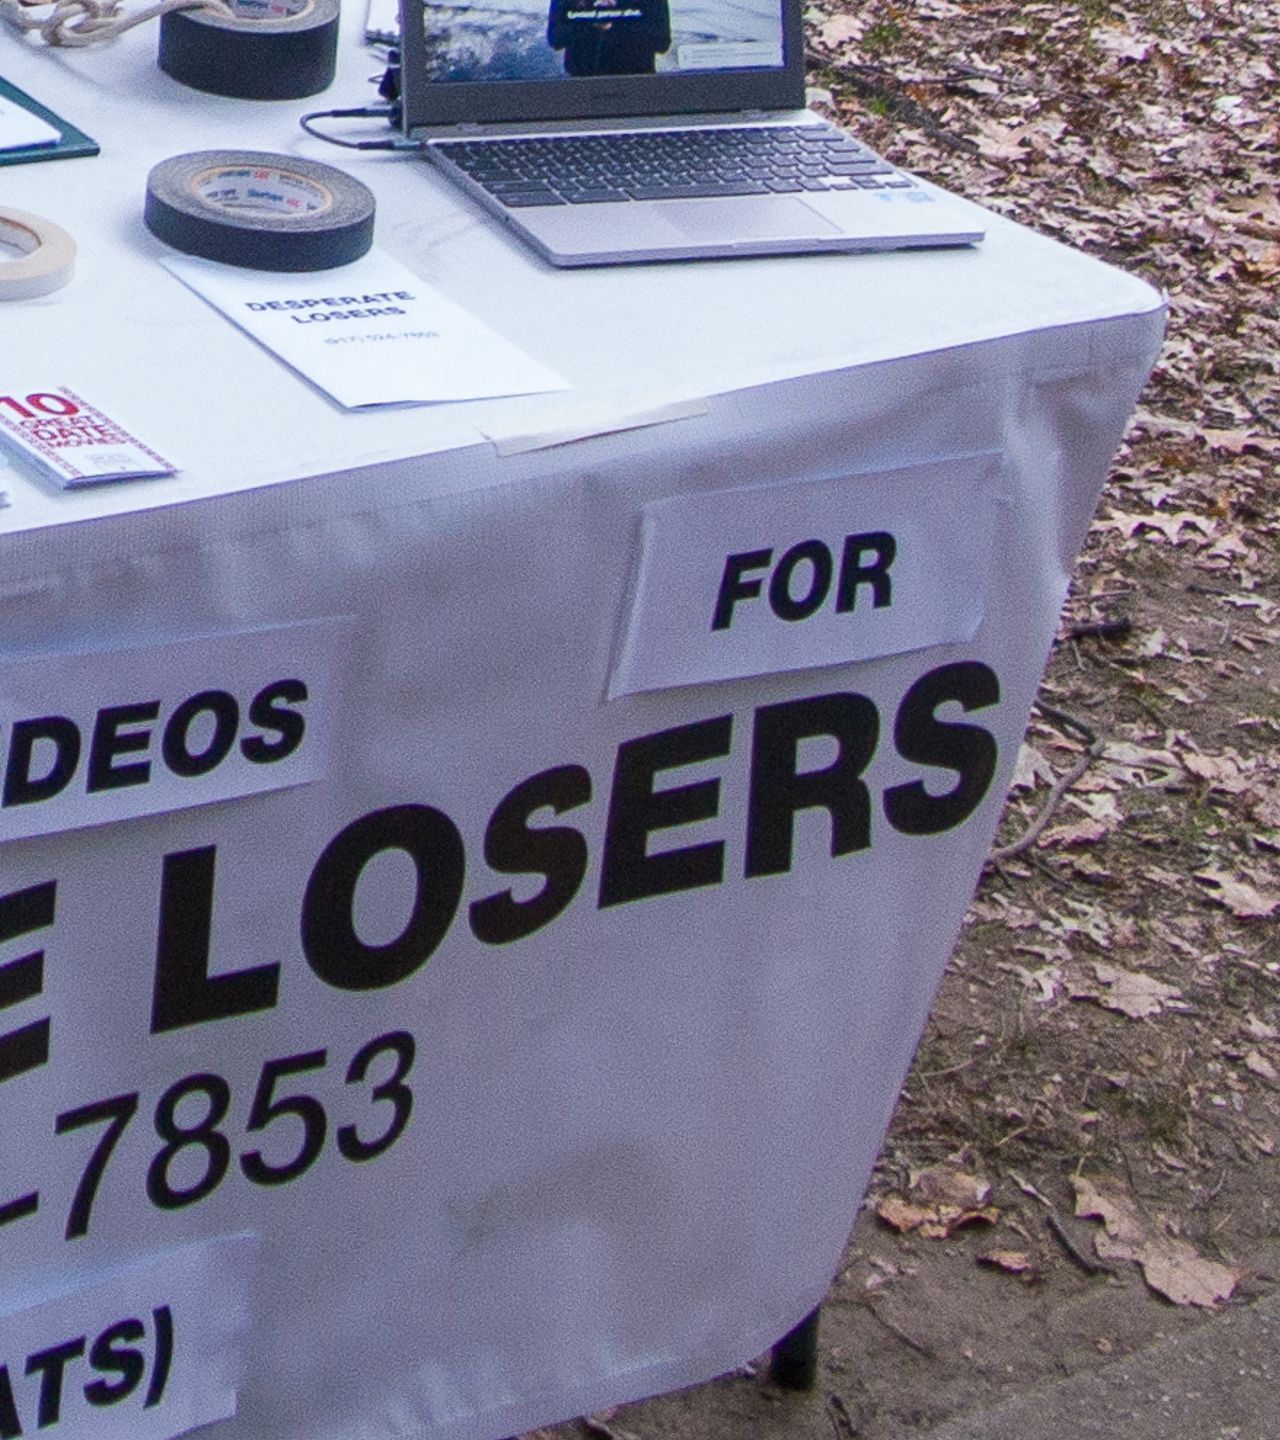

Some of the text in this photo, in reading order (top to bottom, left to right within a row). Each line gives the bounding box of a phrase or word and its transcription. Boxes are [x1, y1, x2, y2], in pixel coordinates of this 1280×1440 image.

[245, 290, 416, 312] DESPERATE
[291, 305, 406, 324] LOSERS
[32, 425, 108, 441] DATE
[712, 532, 896, 630] FOR
[150, 661, 999, 1034] LOSERS
